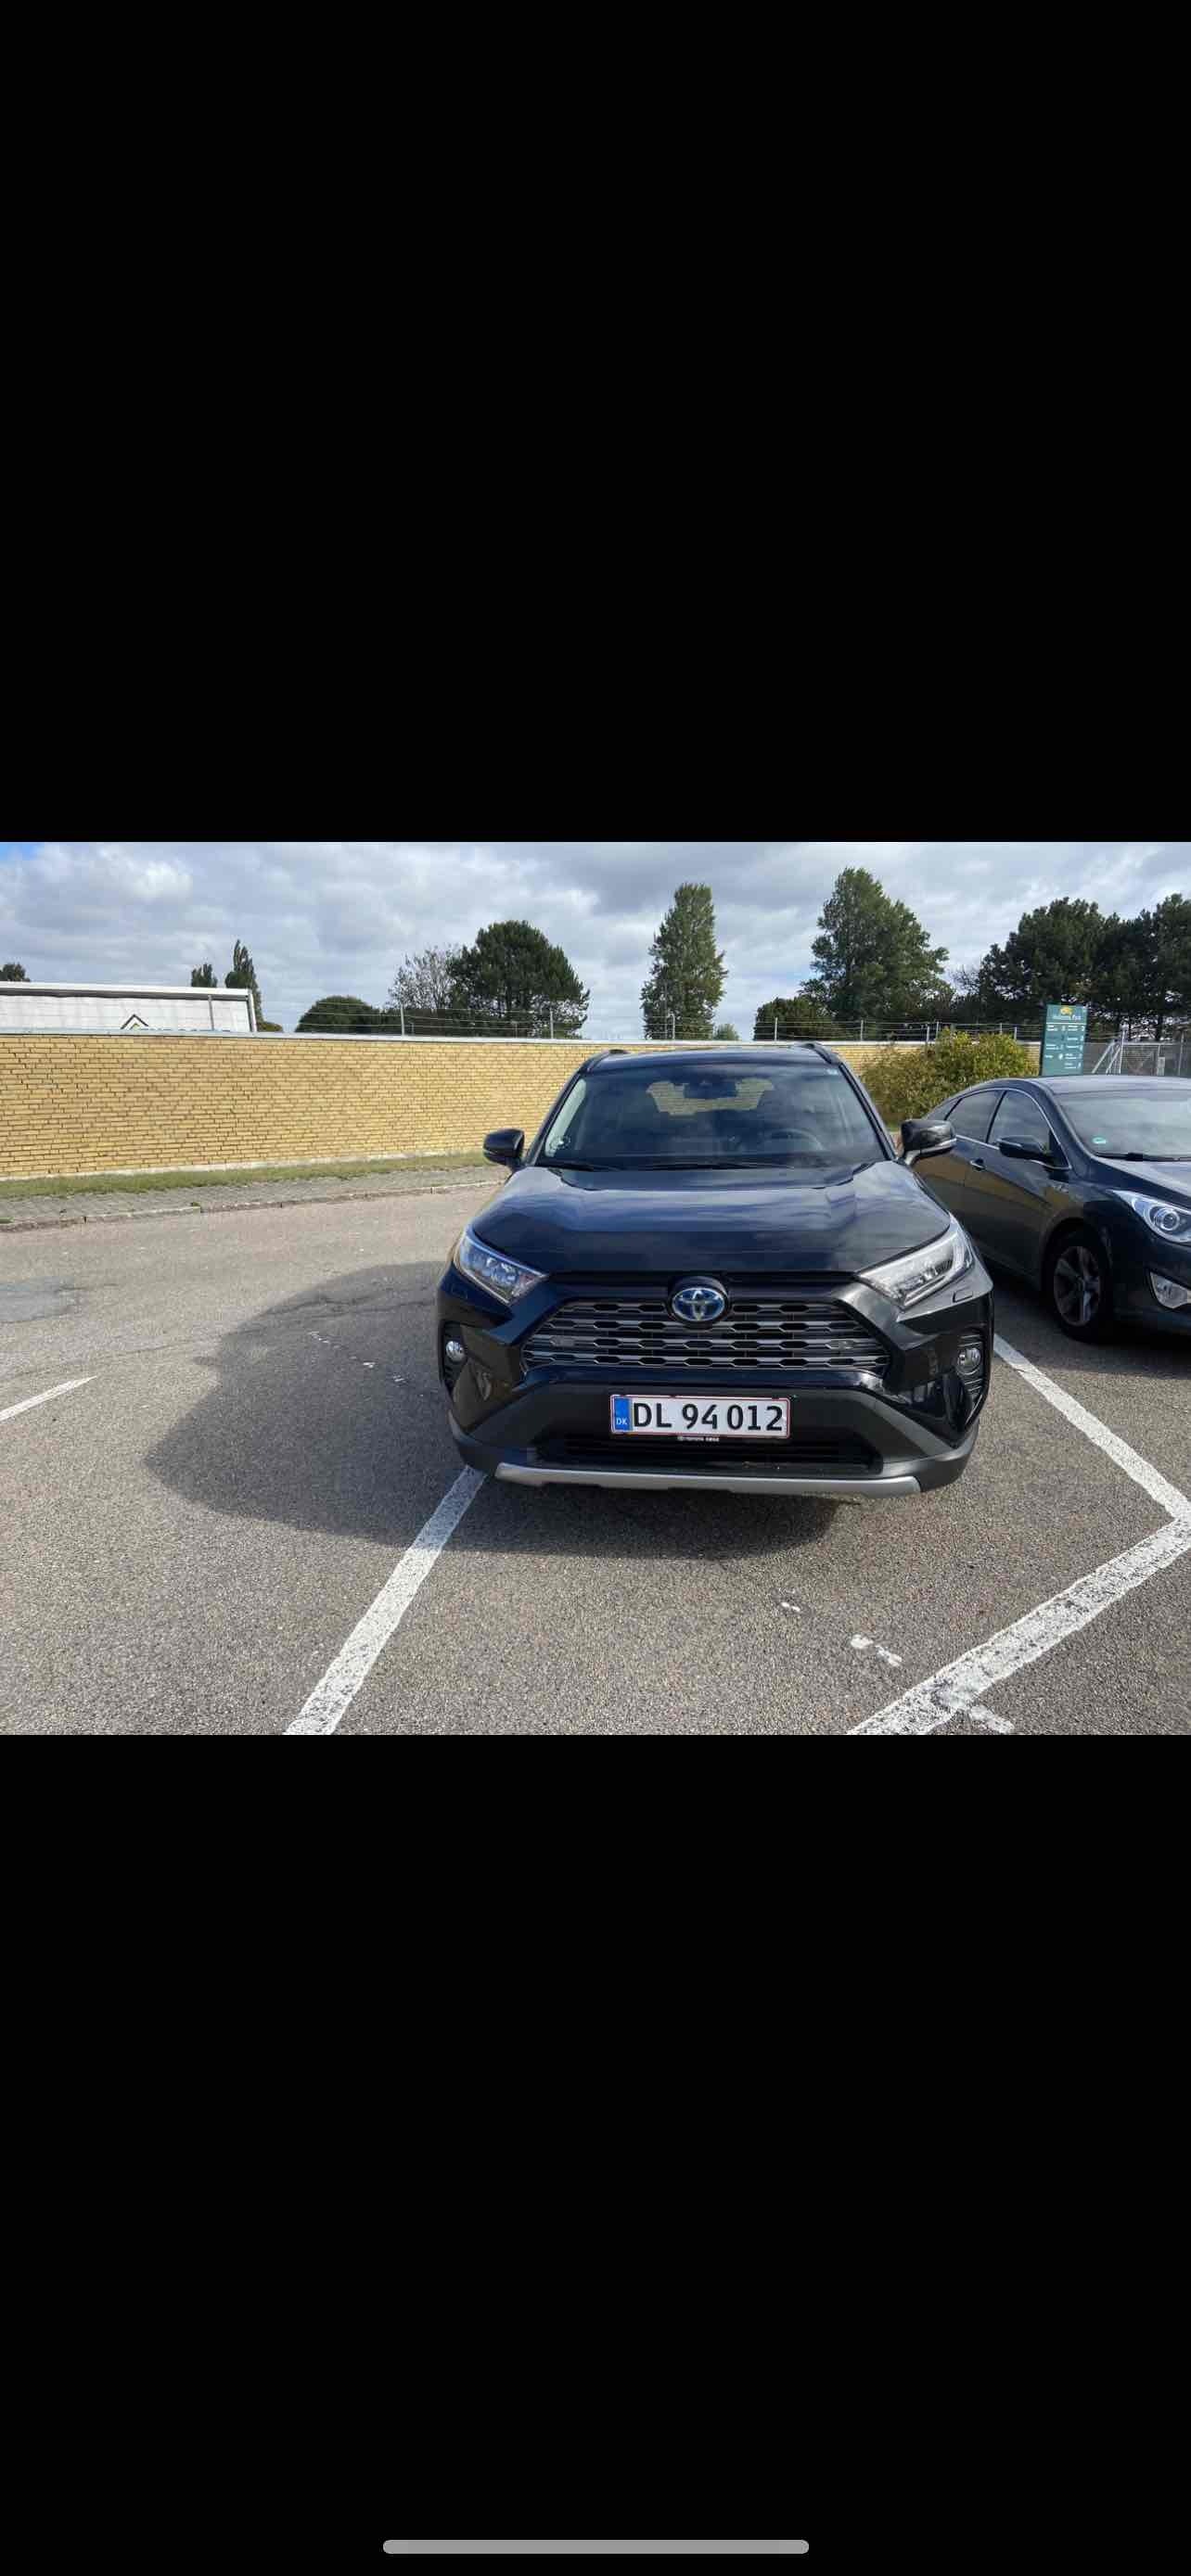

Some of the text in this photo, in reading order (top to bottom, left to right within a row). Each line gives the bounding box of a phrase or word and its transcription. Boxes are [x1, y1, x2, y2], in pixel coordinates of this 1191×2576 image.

[616, 1417, 628, 1425] DK
[633, 1402, 783, 1432] DL 94 012
